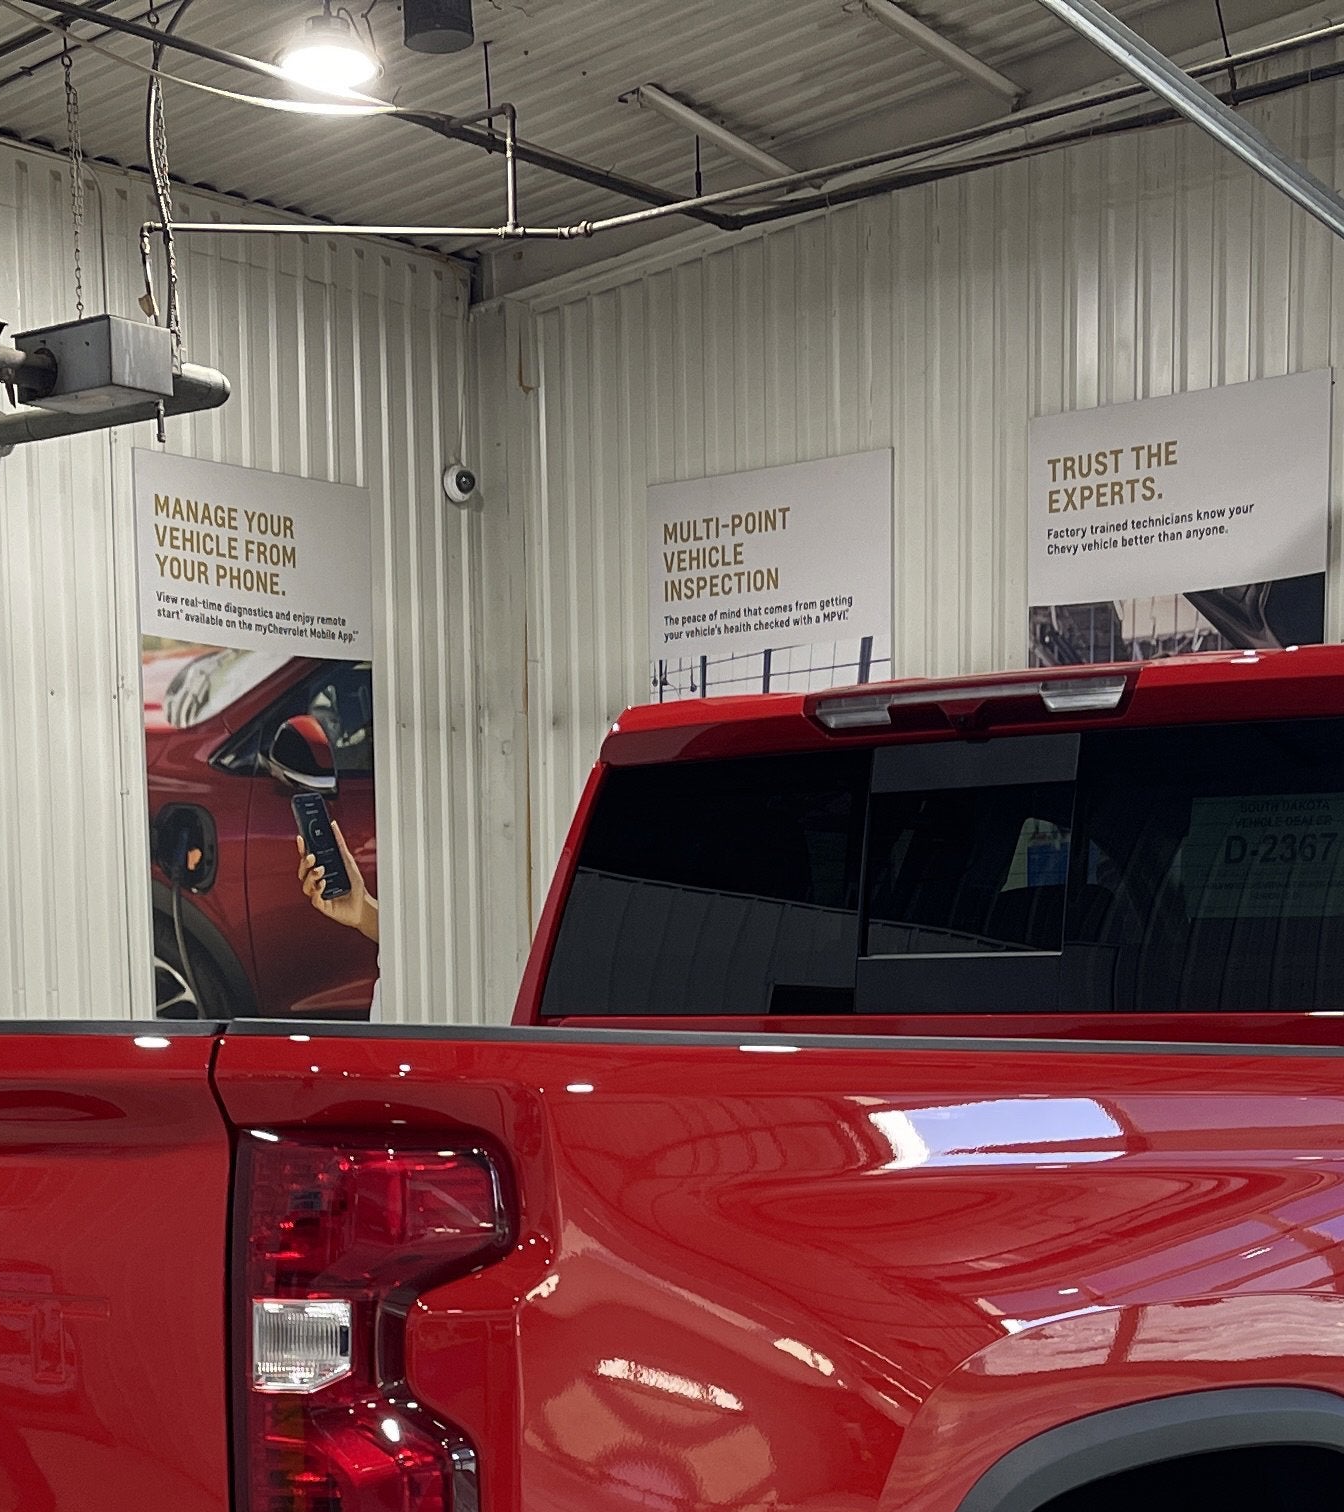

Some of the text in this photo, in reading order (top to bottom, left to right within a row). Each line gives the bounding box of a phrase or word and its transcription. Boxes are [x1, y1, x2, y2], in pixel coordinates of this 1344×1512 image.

[1047, 440, 1178, 482] TRUST THE
[1048, 476, 1163, 514] EXPERTS.
[154, 493, 295, 539] MANAGE YOUR
[663, 506, 791, 545] MULTI-POINT
[1047, 503, 1254, 540] Factory trained technicians know your
[154, 523, 296, 569] VEHICLE FROM
[663, 542, 744, 573] VEHICLE
[1047, 525, 1229, 556] Chevy vehicle better than anyone.
[155, 553, 286, 597] YOUR PHONE.
[664, 567, 779, 603] INSPECTION
[156, 590, 346, 627] View real-time diagnostics and enjoy remote
[185, 612, 223, 627] available
[225, 619, 236, 629] on
[238, 618, 253, 631] the
[255, 622, 308, 638] myChevrolet
[310, 627, 336, 641] Mobile
[664, 595, 853, 627] The peace of mind that comes from getting
[664, 630, 683, 644] your
[685, 622, 722, 639] vehicle's
[724, 620, 752, 635] health
[754, 615, 791, 632] checked
[792, 613, 812, 626] with
[815, 615, 821, 624] a
[1234, 814, 1333, 829] VEHICLE DEALER
[1240, 799, 1331, 814] SOUTH DAKOTA
[1224, 832, 1338, 865] D-2367
